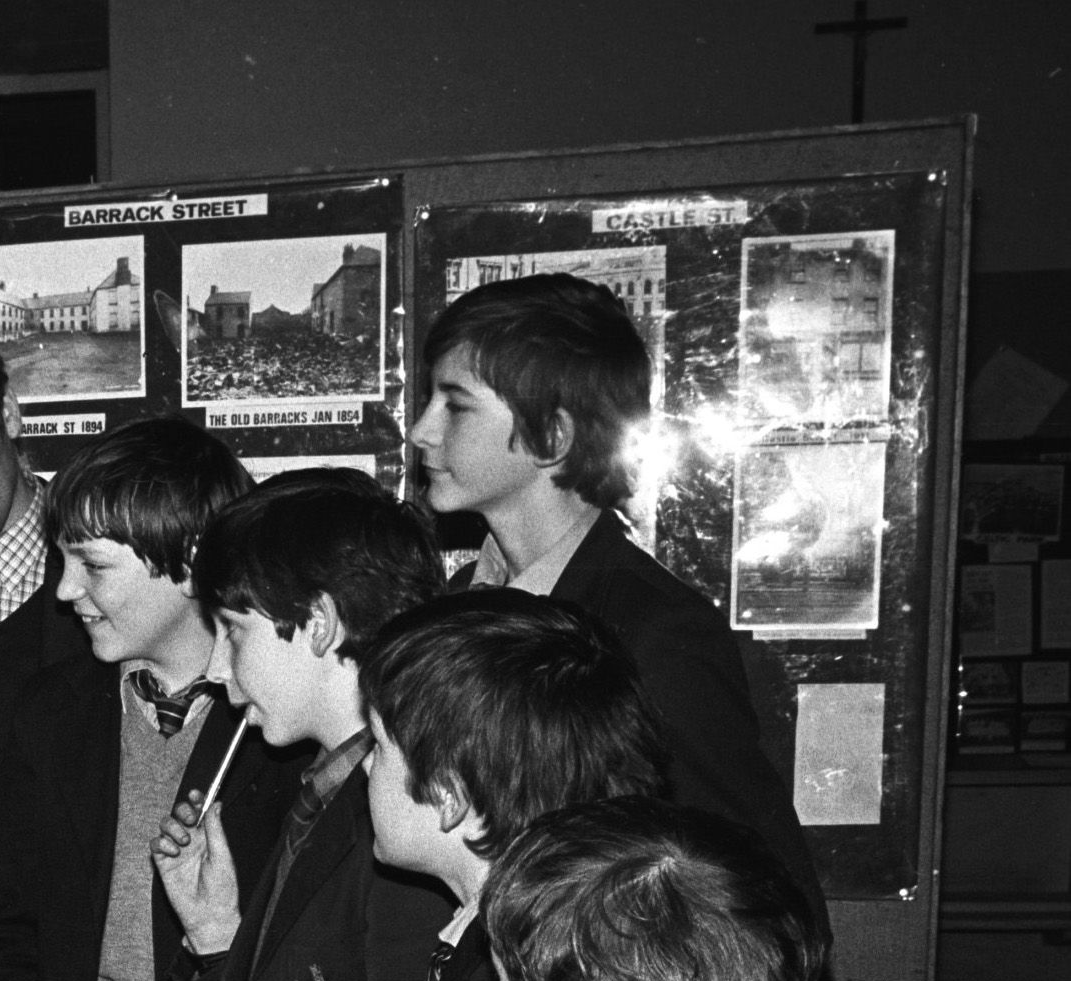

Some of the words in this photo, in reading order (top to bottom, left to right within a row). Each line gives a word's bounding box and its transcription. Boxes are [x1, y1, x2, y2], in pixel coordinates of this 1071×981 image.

[69, 206, 165, 226] BARRACK
[172, 200, 247, 219] STREET
[606, 209, 696, 230] CASTLE
[21, 422, 58, 434] ARRACK
[64, 421, 75, 433] ST
[82, 421, 103, 432] 1894
[210, 414, 227, 426] THE
[231, 413, 250, 425] OLD
[253, 411, 308, 425] BARRACKS
[311, 411, 333, 423] JAN
